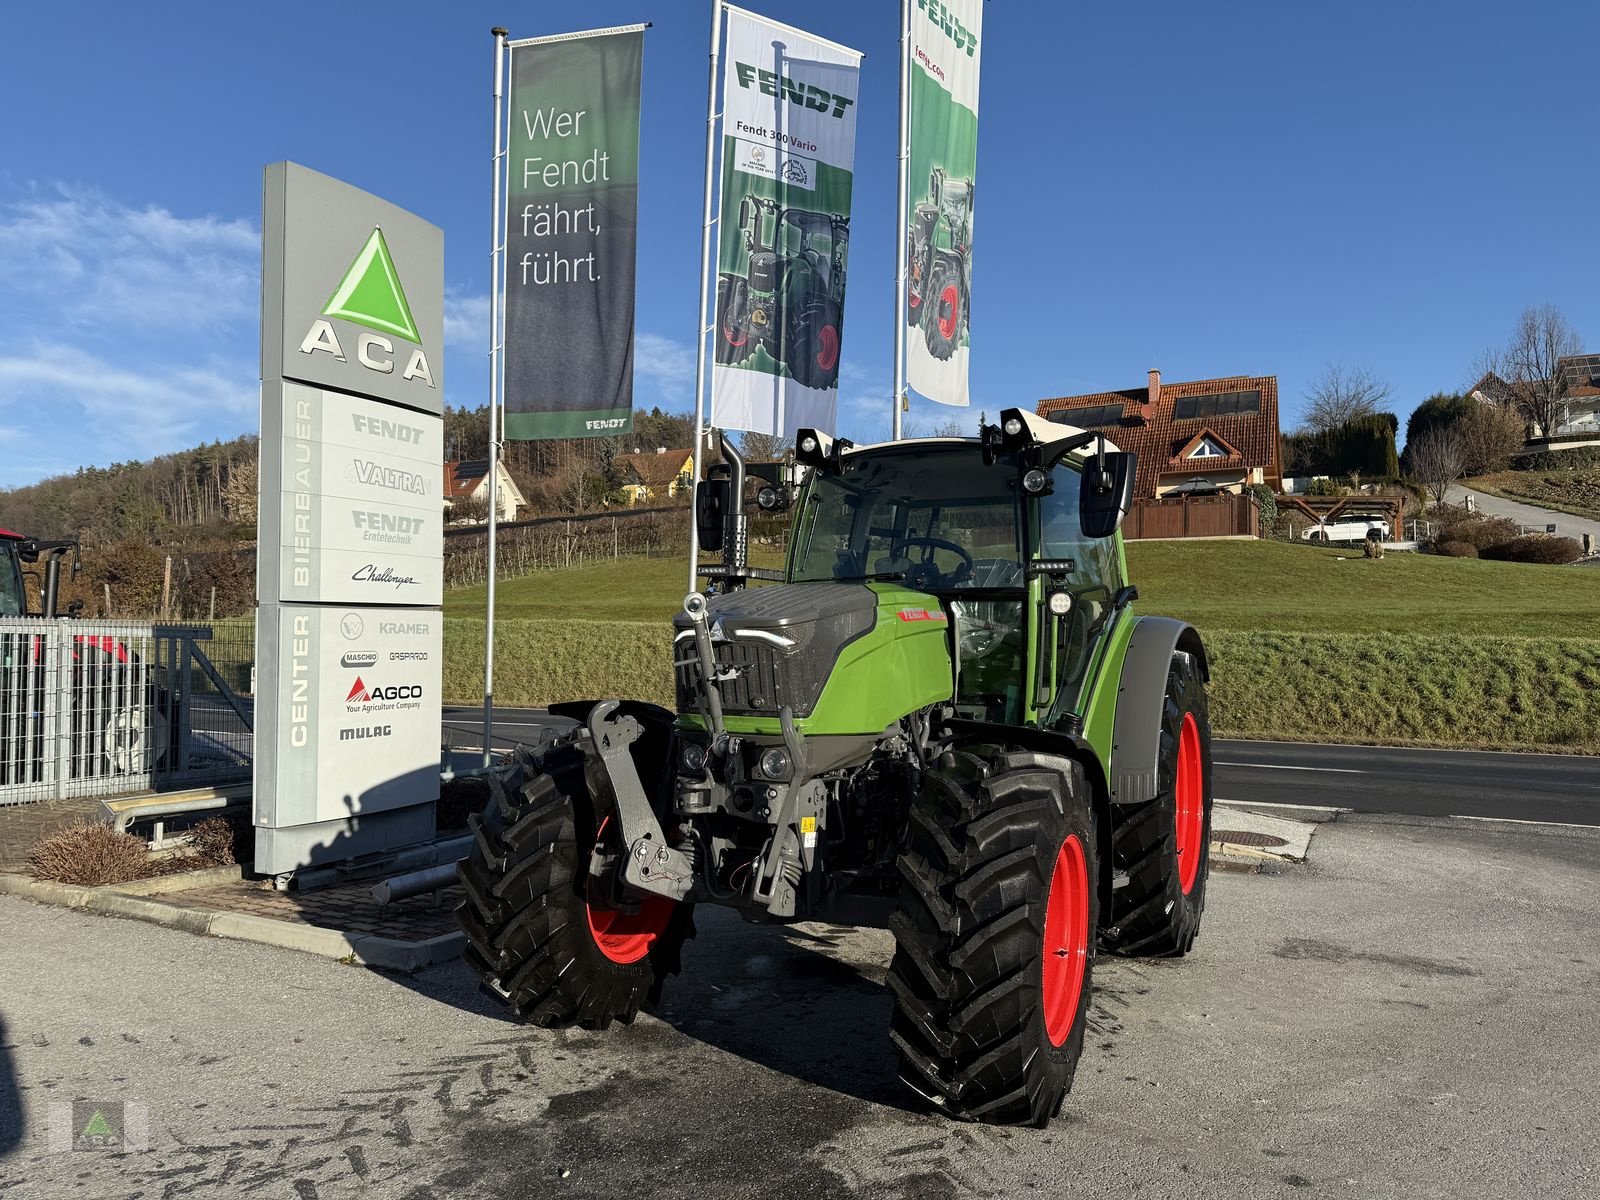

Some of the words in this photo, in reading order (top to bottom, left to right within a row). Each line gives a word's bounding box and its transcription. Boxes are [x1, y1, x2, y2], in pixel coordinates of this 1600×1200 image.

[735, 61, 854, 119] FENDT
[523, 107, 586, 141] Wer
[736, 120, 768, 138] Fendt
[770, 130, 789, 144] 300
[790, 136, 817, 152] Vario
[523, 148, 610, 189] Fendt
[521, 202, 601, 237] fährt,
[520, 251, 601, 286] führt.
[298, 318, 436, 389] ACA
[352, 413, 425, 445] FENDT
[585, 418, 627, 430] FENDT
[353, 459, 425, 495] VALTRA
[294, 399, 312, 588] BIERBAUER
[352, 510, 425, 535] FENDT
[363, 530, 412, 545] Erntetechnik
[352, 564, 422, 590] Challenger
[379, 622, 430, 635] KRAMER
[346, 653, 377, 661] MASCHIO
[389, 652, 428, 661] GASPARDO
[291, 614, 309, 748] CENTER
[371, 685, 422, 700] AGCO
[346, 705, 361, 713] Your
[362, 702, 395, 714] Agriculture
[396, 701, 421, 710] Company
[340, 725, 392, 740] MULAG
